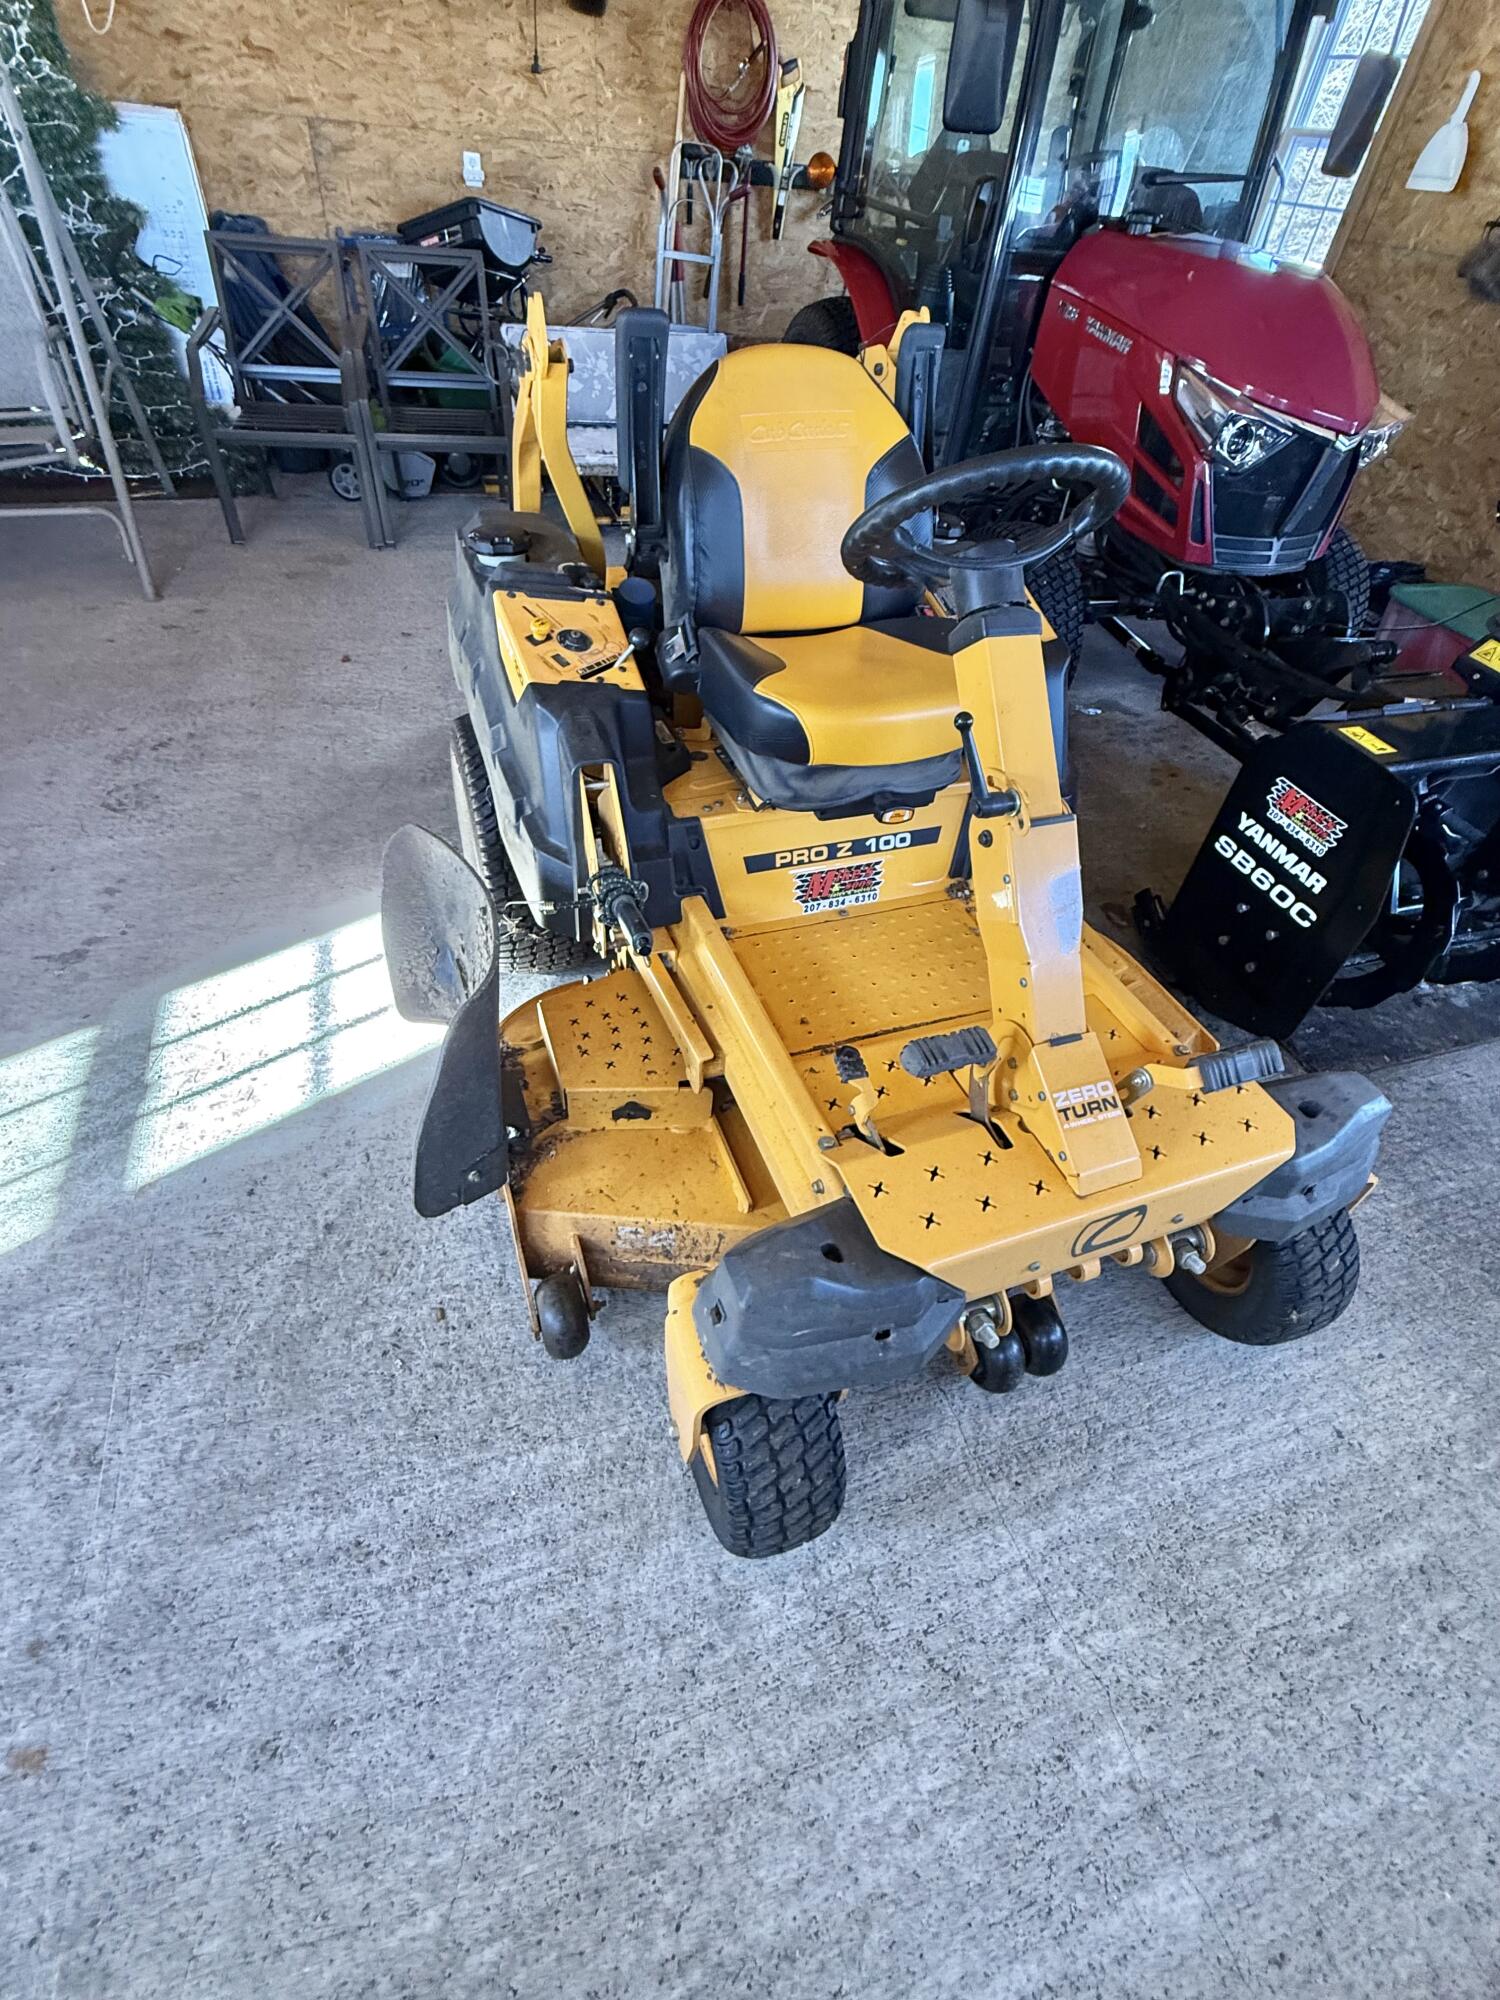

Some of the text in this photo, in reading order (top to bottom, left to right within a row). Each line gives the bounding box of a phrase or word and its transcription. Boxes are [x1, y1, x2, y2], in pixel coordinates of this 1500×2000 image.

[775, 832, 912, 868] PRO Z 100
[1238, 811, 1328, 895] YANMAR
[1214, 834, 1318, 928] SB60C
[1053, 1080, 1114, 1108] ZERO
[1058, 1096, 1119, 1121] TURN
